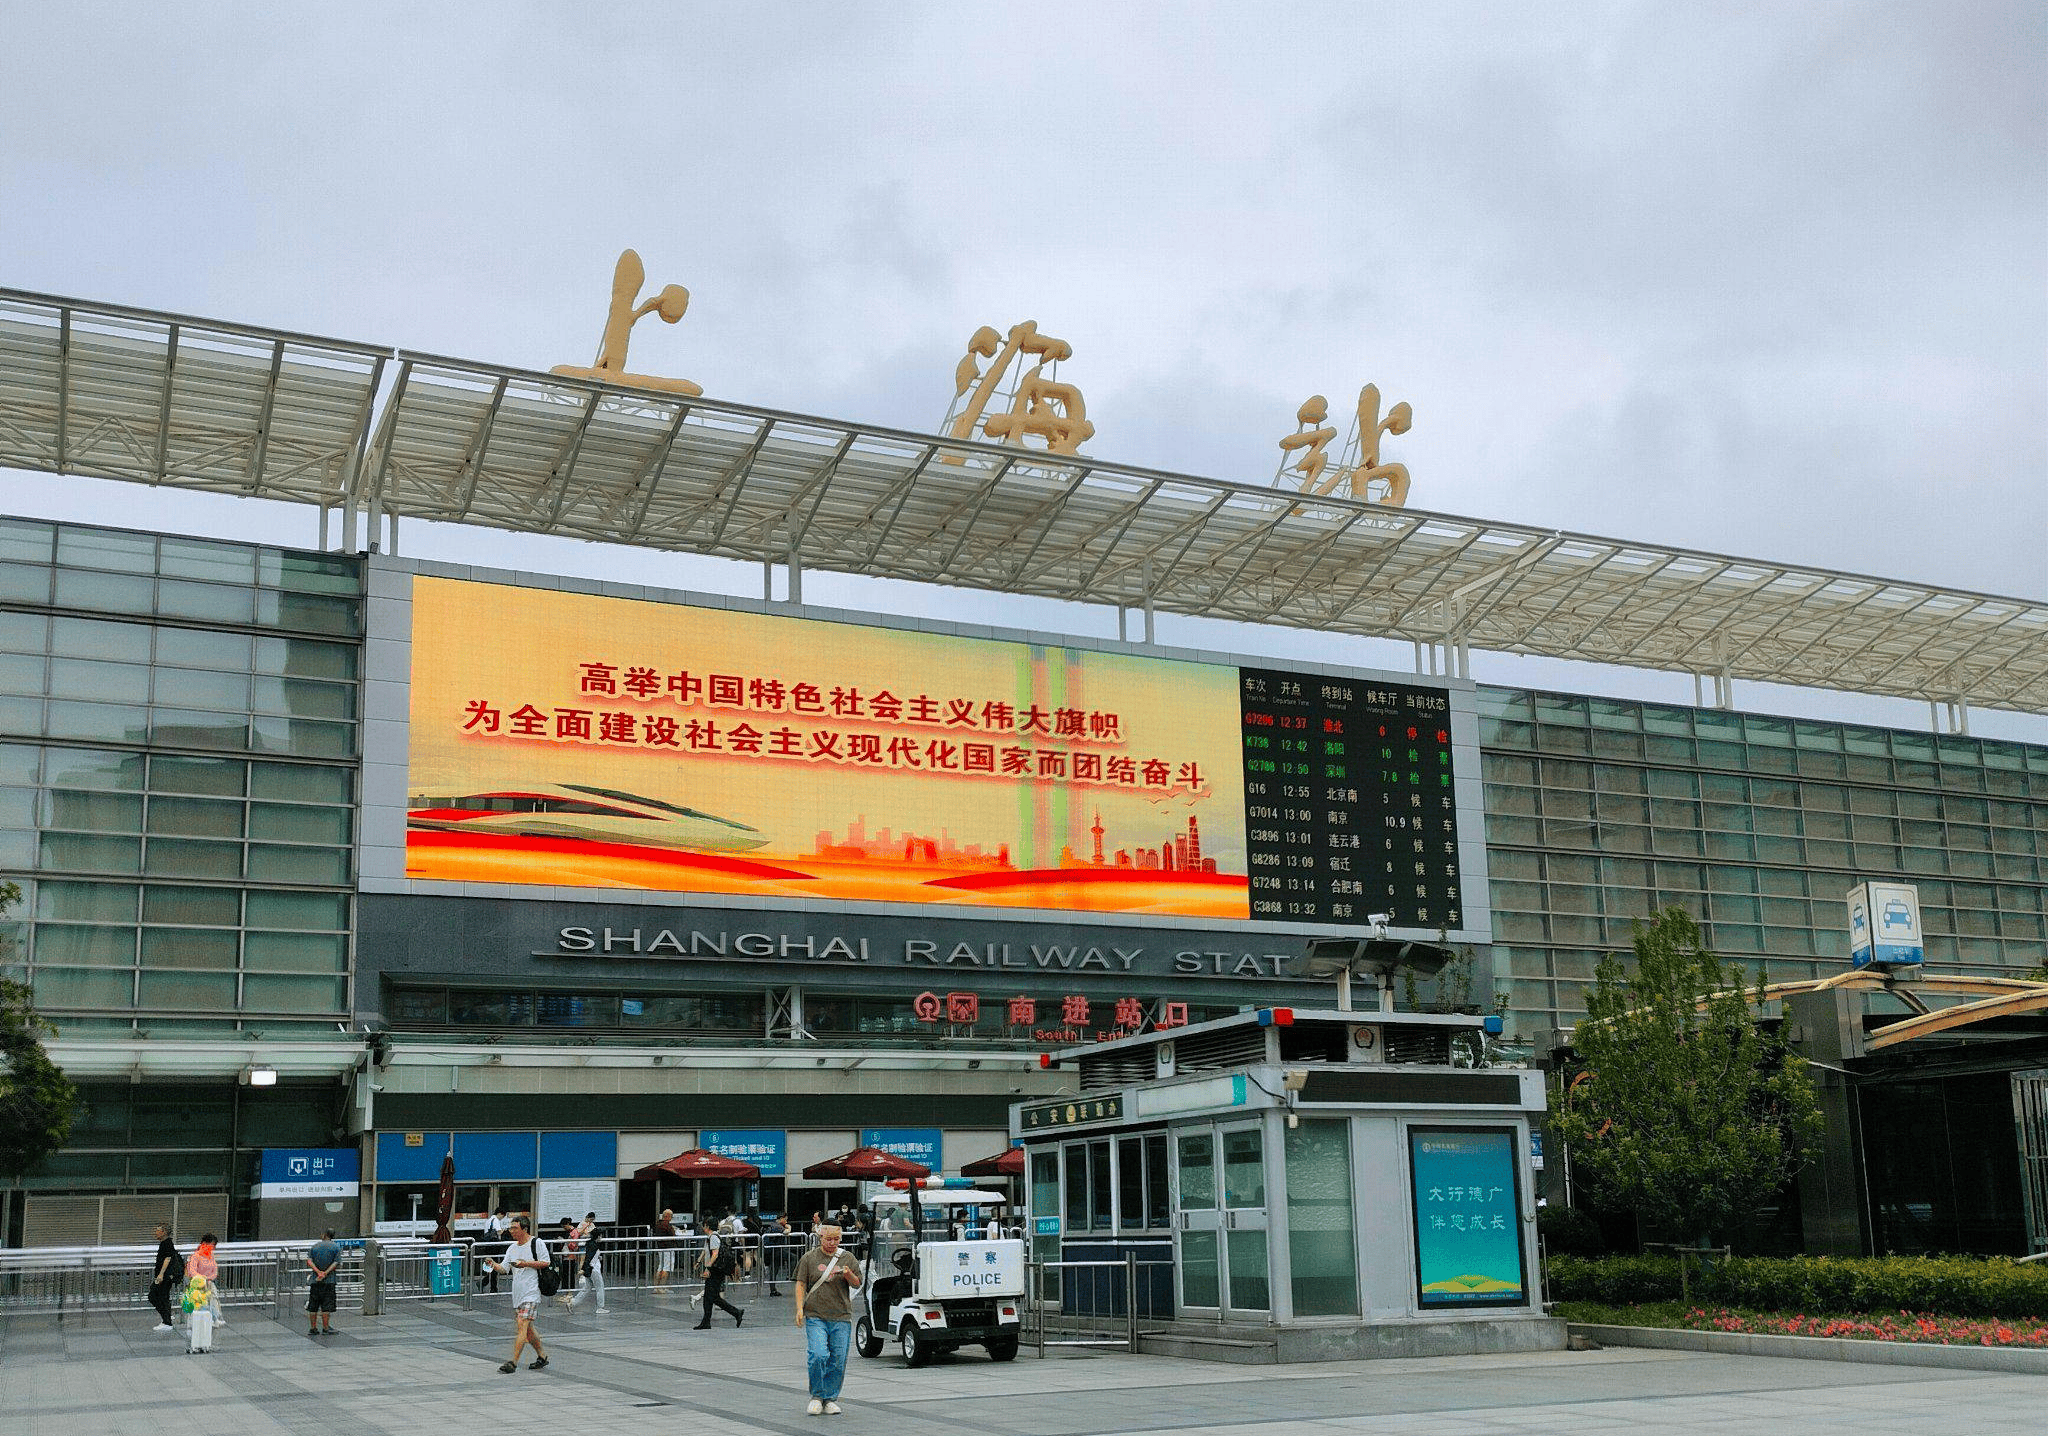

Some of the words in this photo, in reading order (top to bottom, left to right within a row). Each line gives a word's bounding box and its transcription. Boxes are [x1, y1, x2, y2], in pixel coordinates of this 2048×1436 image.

[579, 662, 1119, 739] 高举中国特色社会主义伟大旗帜
[1245, 678, 1266, 693] 车次
[1281, 682, 1301, 697] 开点
[1321, 686, 1353, 702] 终到站
[1366, 690, 1398, 706] 候车厅
[1406, 694, 1446, 711] 当前状态
[464, 700, 1204, 790] 为全面建设社会主义现代化国家而团结奋斗
[1382, 748, 1392, 759] 10
[1248, 782, 1266, 794] G16
[1326, 788, 1358, 803] 北京南
[1382, 793, 1388, 804] 5
[1249, 806, 1278, 820] G7014
[1328, 811, 1348, 824] 南京
[1250, 830, 1280, 842] C3896
[1328, 833, 1361, 849] 连云港
[1386, 839, 1392, 850] 6
[1252, 853, 1280, 866] G8286
[1330, 856, 1351, 872] 宿迁
[1386, 862, 1393, 872] 8
[1252, 876, 1281, 890] G7248
[1330, 878, 1363, 895] 合肥南
[1388, 884, 1394, 895] 6
[1332, 904, 1354, 918] 南京
[1389, 908, 1396, 918] 5
[559, 926, 870, 961] SHANGHAI
[905, 940, 1143, 971] RAILWAY
[1175, 951, 1294, 976] STAT
[1008, 995, 1188, 1029] 南进站口
[1035, 1030, 1078, 1041] South
[313, 1157, 334, 1168] 出口
[1428, 1186, 1503, 1202] 大行德广
[1430, 1214, 1506, 1232] 伴您成长
[958, 1250, 997, 1266] 警察
[954, 1273, 1002, 1286] POLICE
